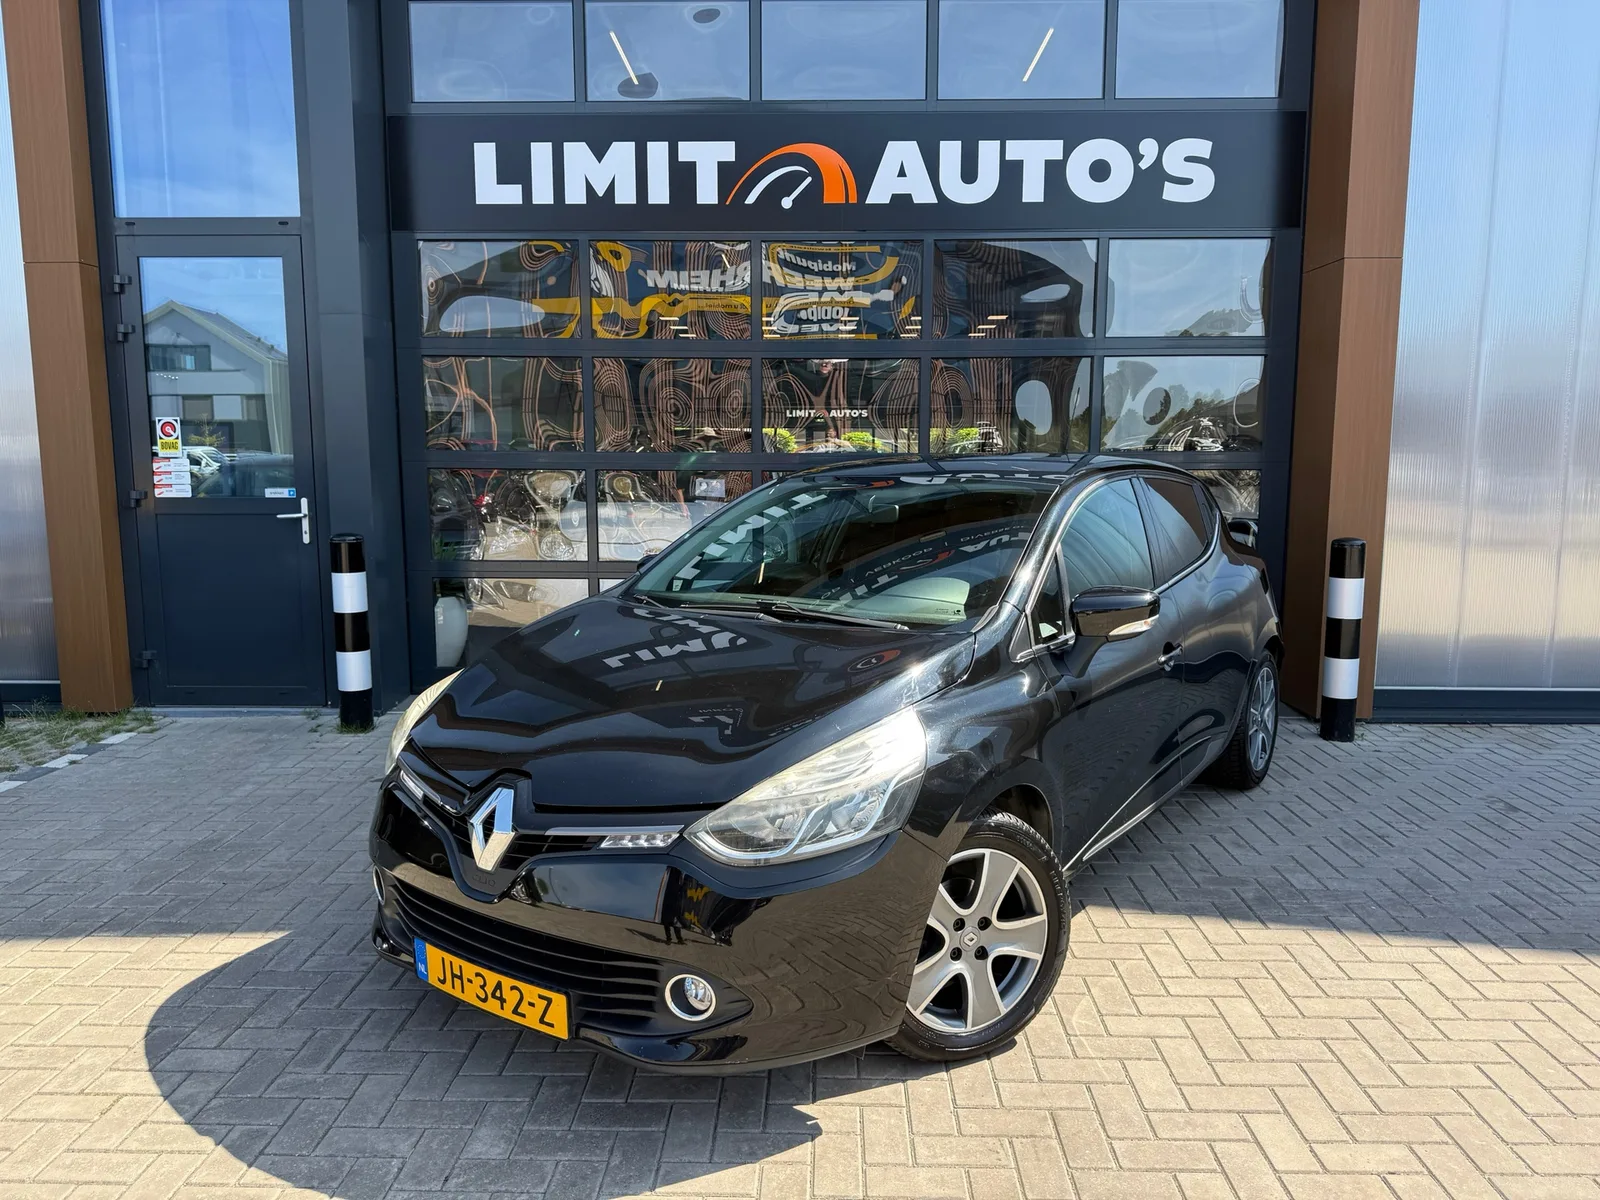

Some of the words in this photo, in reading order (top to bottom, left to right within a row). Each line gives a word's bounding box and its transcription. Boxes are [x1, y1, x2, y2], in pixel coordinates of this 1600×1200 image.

[474, 141, 736, 205] LIMIT
[865, 137, 1216, 205] AUTO'S
[786, 409, 816, 418] LIMIT
[829, 409, 868, 418] AUTO'S
[160, 441, 179, 450] BOVAG
[472, 874, 496, 887] CLIO
[418, 962, 428, 975] NL
[437, 956, 555, 1029] JH-342-Z
